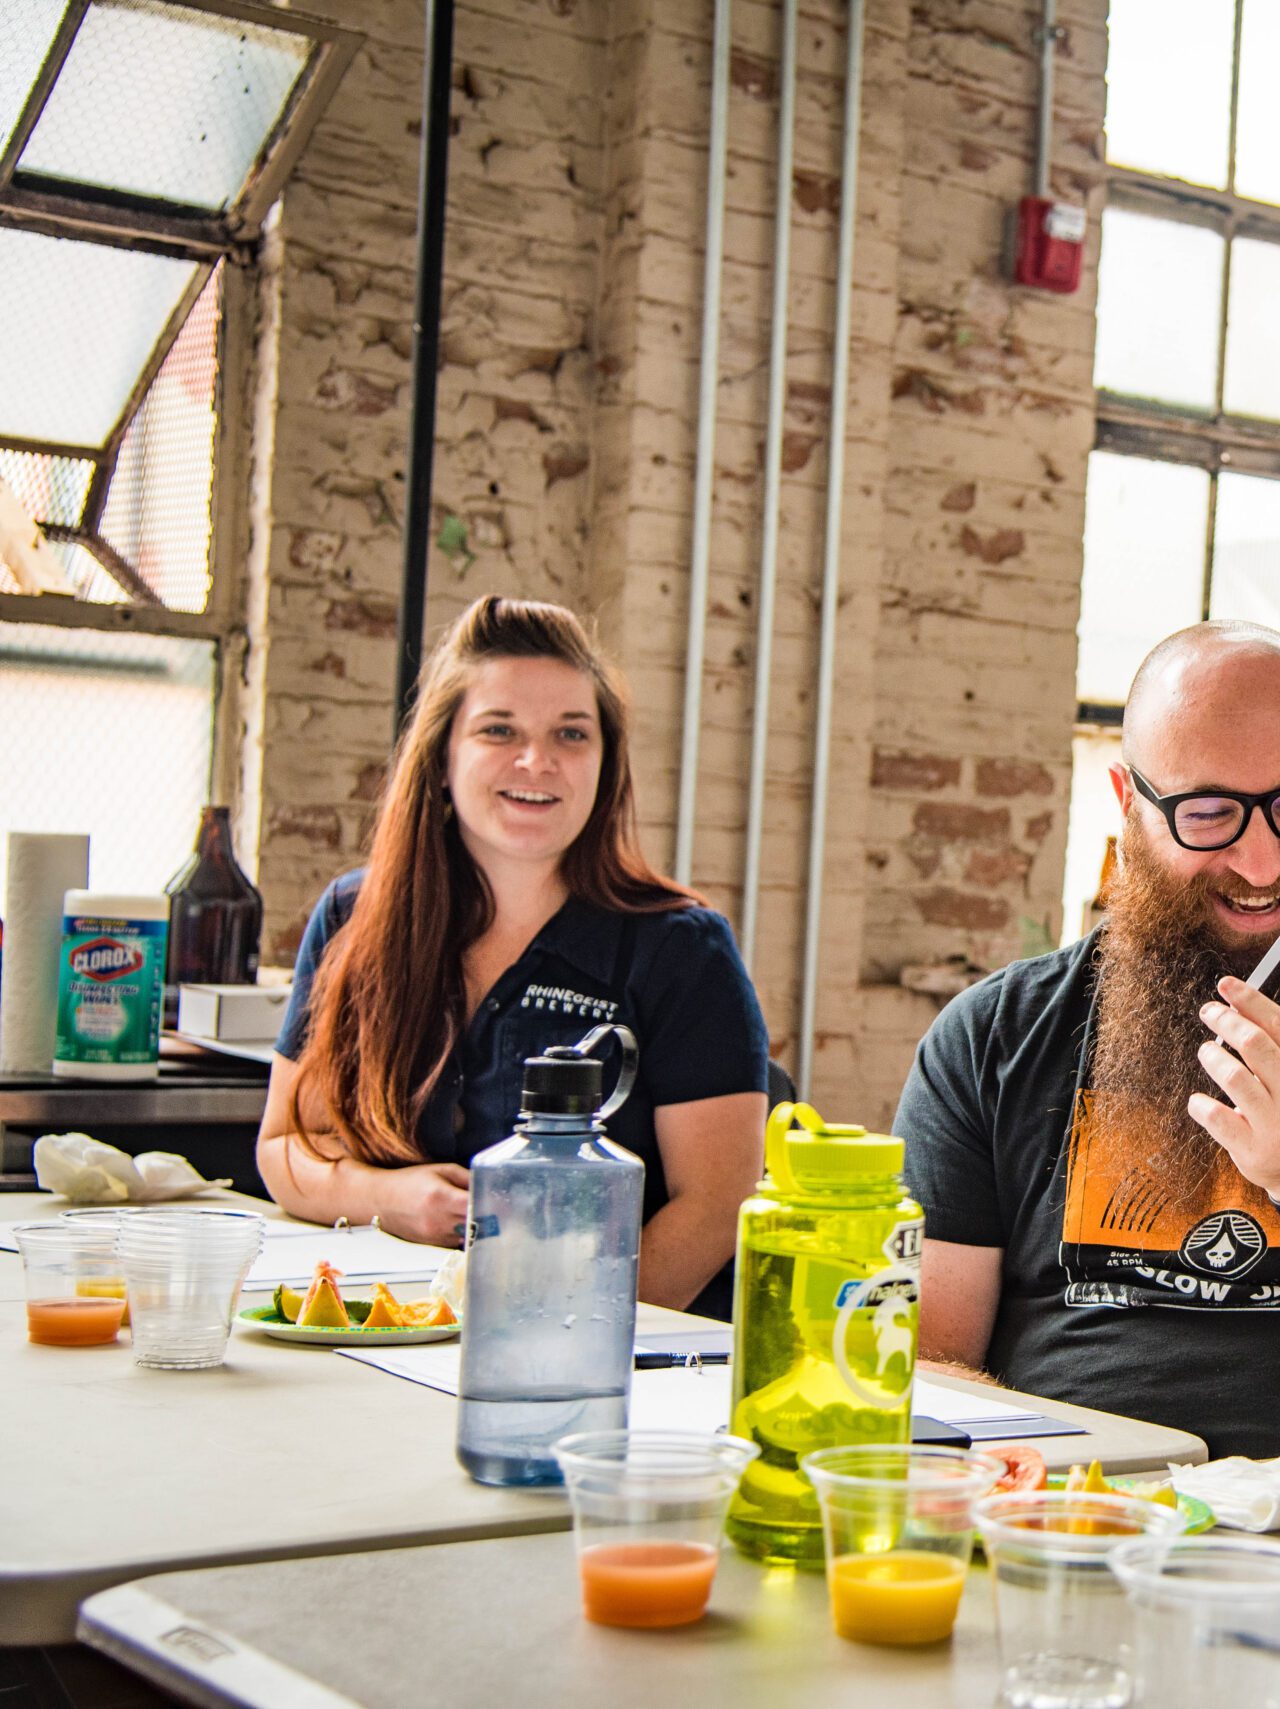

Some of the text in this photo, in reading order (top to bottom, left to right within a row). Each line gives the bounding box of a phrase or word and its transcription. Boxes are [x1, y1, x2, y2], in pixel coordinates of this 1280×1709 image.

[74, 943, 137, 973] CLOROX
[521, 996, 614, 1021] BREWERY
[525, 984, 619, 1012] RHINEGEIST
[1135, 1266, 1231, 1302] SLOW
